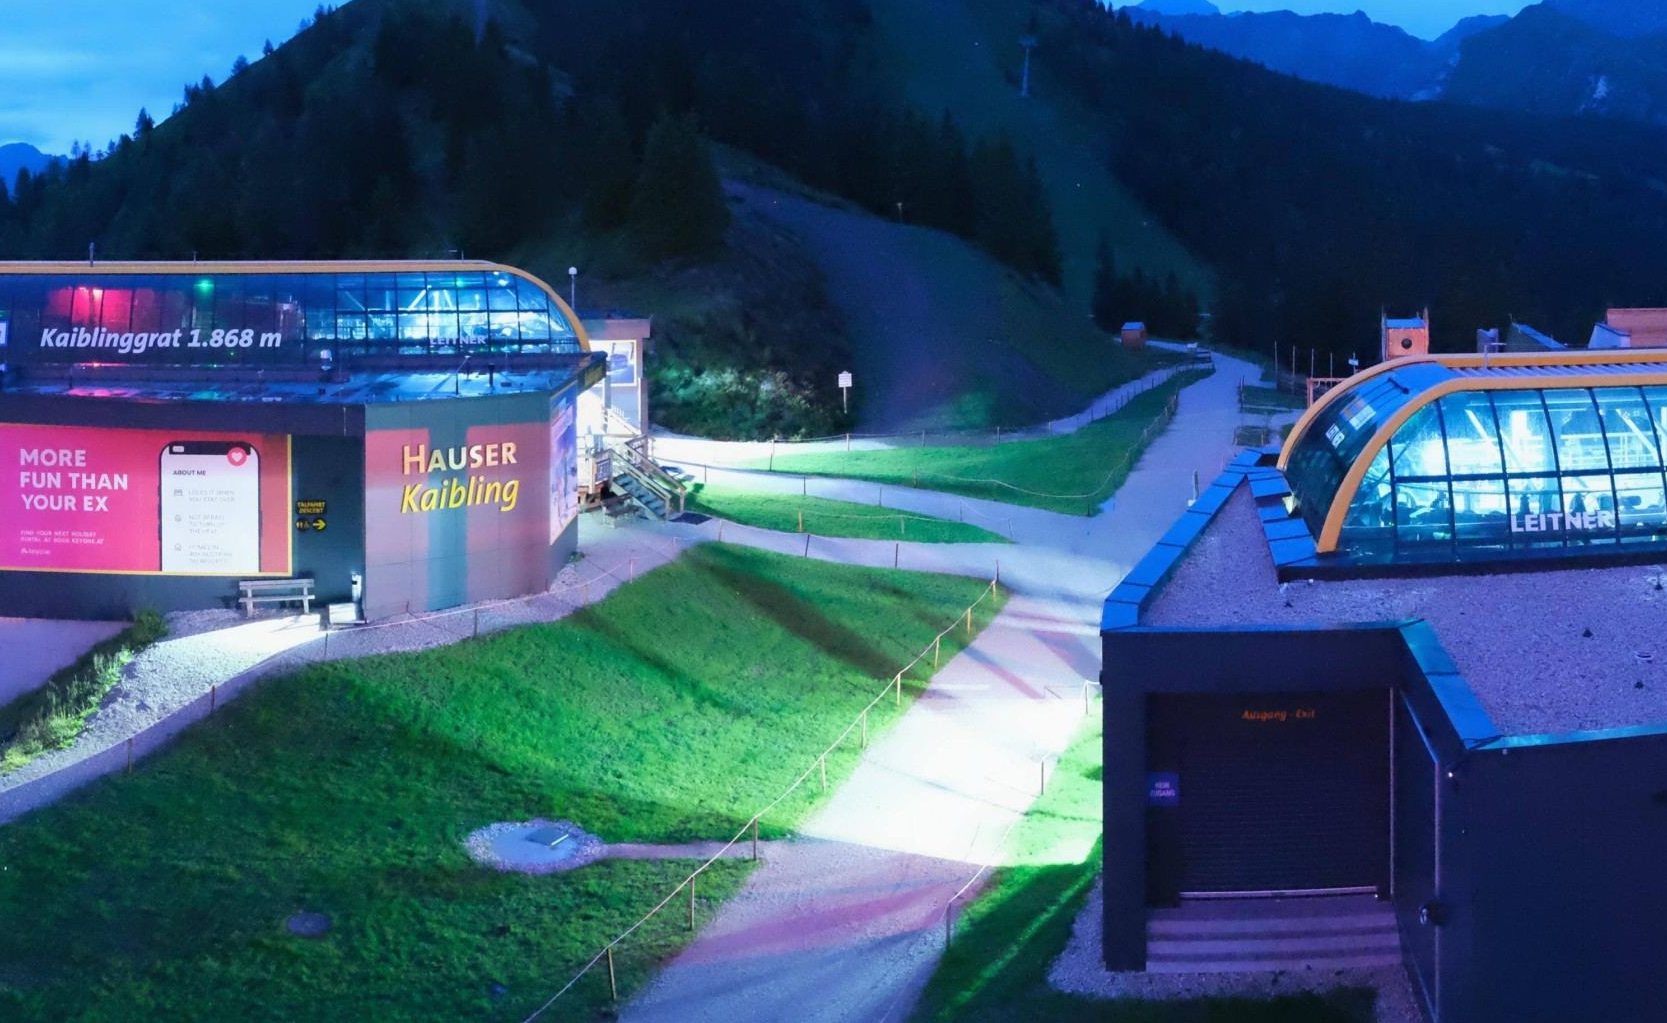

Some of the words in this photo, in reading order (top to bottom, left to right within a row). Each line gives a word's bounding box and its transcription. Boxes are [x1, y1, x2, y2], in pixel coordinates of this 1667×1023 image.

[40, 327, 182, 353] Kaiblinggrat
[187, 328, 254, 348] 1.868
[259, 332, 282, 348] m
[429, 335, 487, 345] LEITNER
[20, 448, 87, 467] MORE
[403, 442, 518, 475] HAUSER
[20, 471, 62, 489] FUN
[68, 472, 128, 491] THAN
[21, 493, 77, 511] YOUR
[83, 495, 109, 512] EX
[401, 475, 520, 514] Kaibling
[1510, 510, 1616, 533] LEITNER
[1242, 709, 1288, 722] Ausgang
